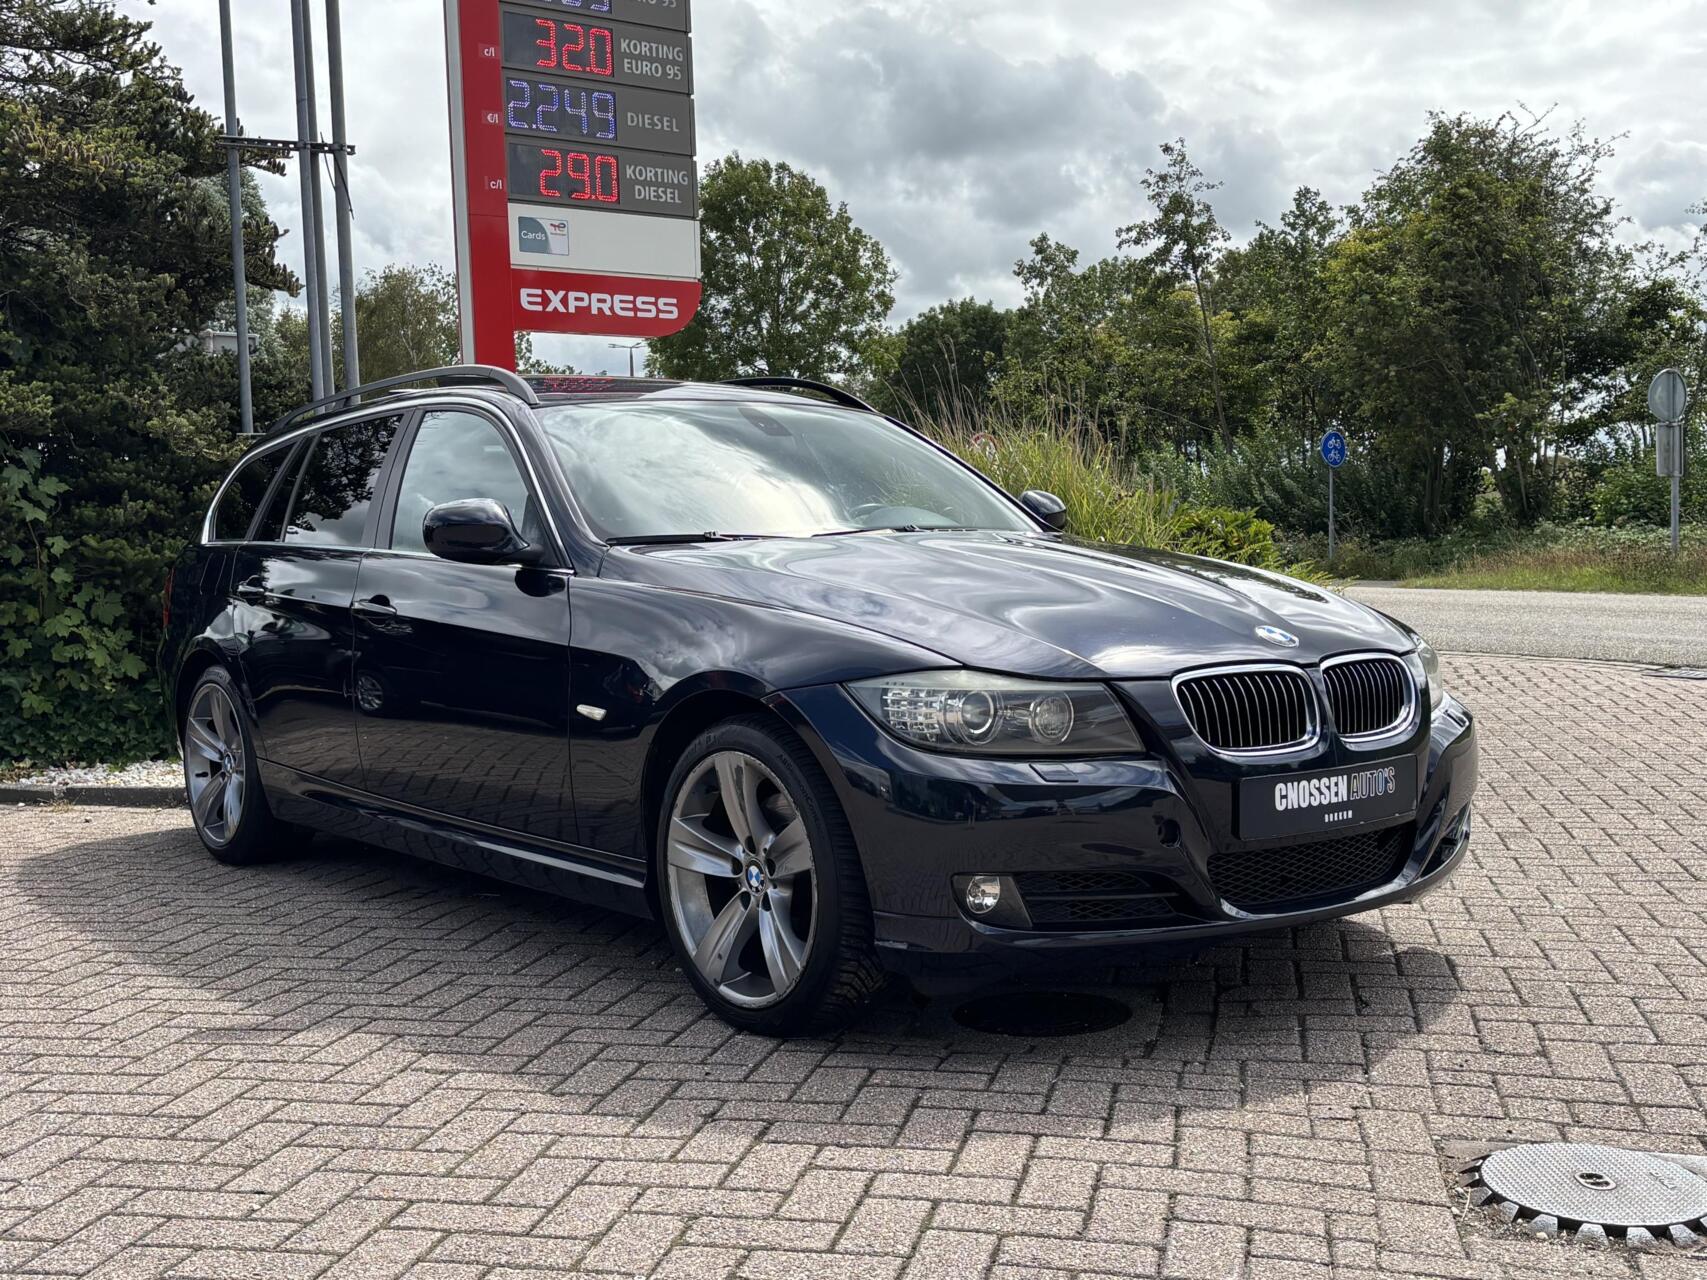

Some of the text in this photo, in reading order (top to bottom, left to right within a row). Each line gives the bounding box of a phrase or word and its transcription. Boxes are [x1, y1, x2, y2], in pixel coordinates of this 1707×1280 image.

[484, 47, 495, 57] c/l
[535, 18, 613, 76] 32.0
[620, 38, 683, 62] KORTING
[623, 58, 682, 80] EURO 95
[507, 79, 616, 139] 2.249
[627, 112, 680, 132] DIESEL
[490, 179, 503, 190] c/l
[539, 148, 618, 203] 29.0
[625, 164, 689, 185] KORTING
[634, 185, 682, 203] DIESEL
[521, 230, 546, 241] Cards
[519, 287, 679, 320] EXPRESS
[1274, 766, 1396, 811] CNOSSEN AUTO'S
